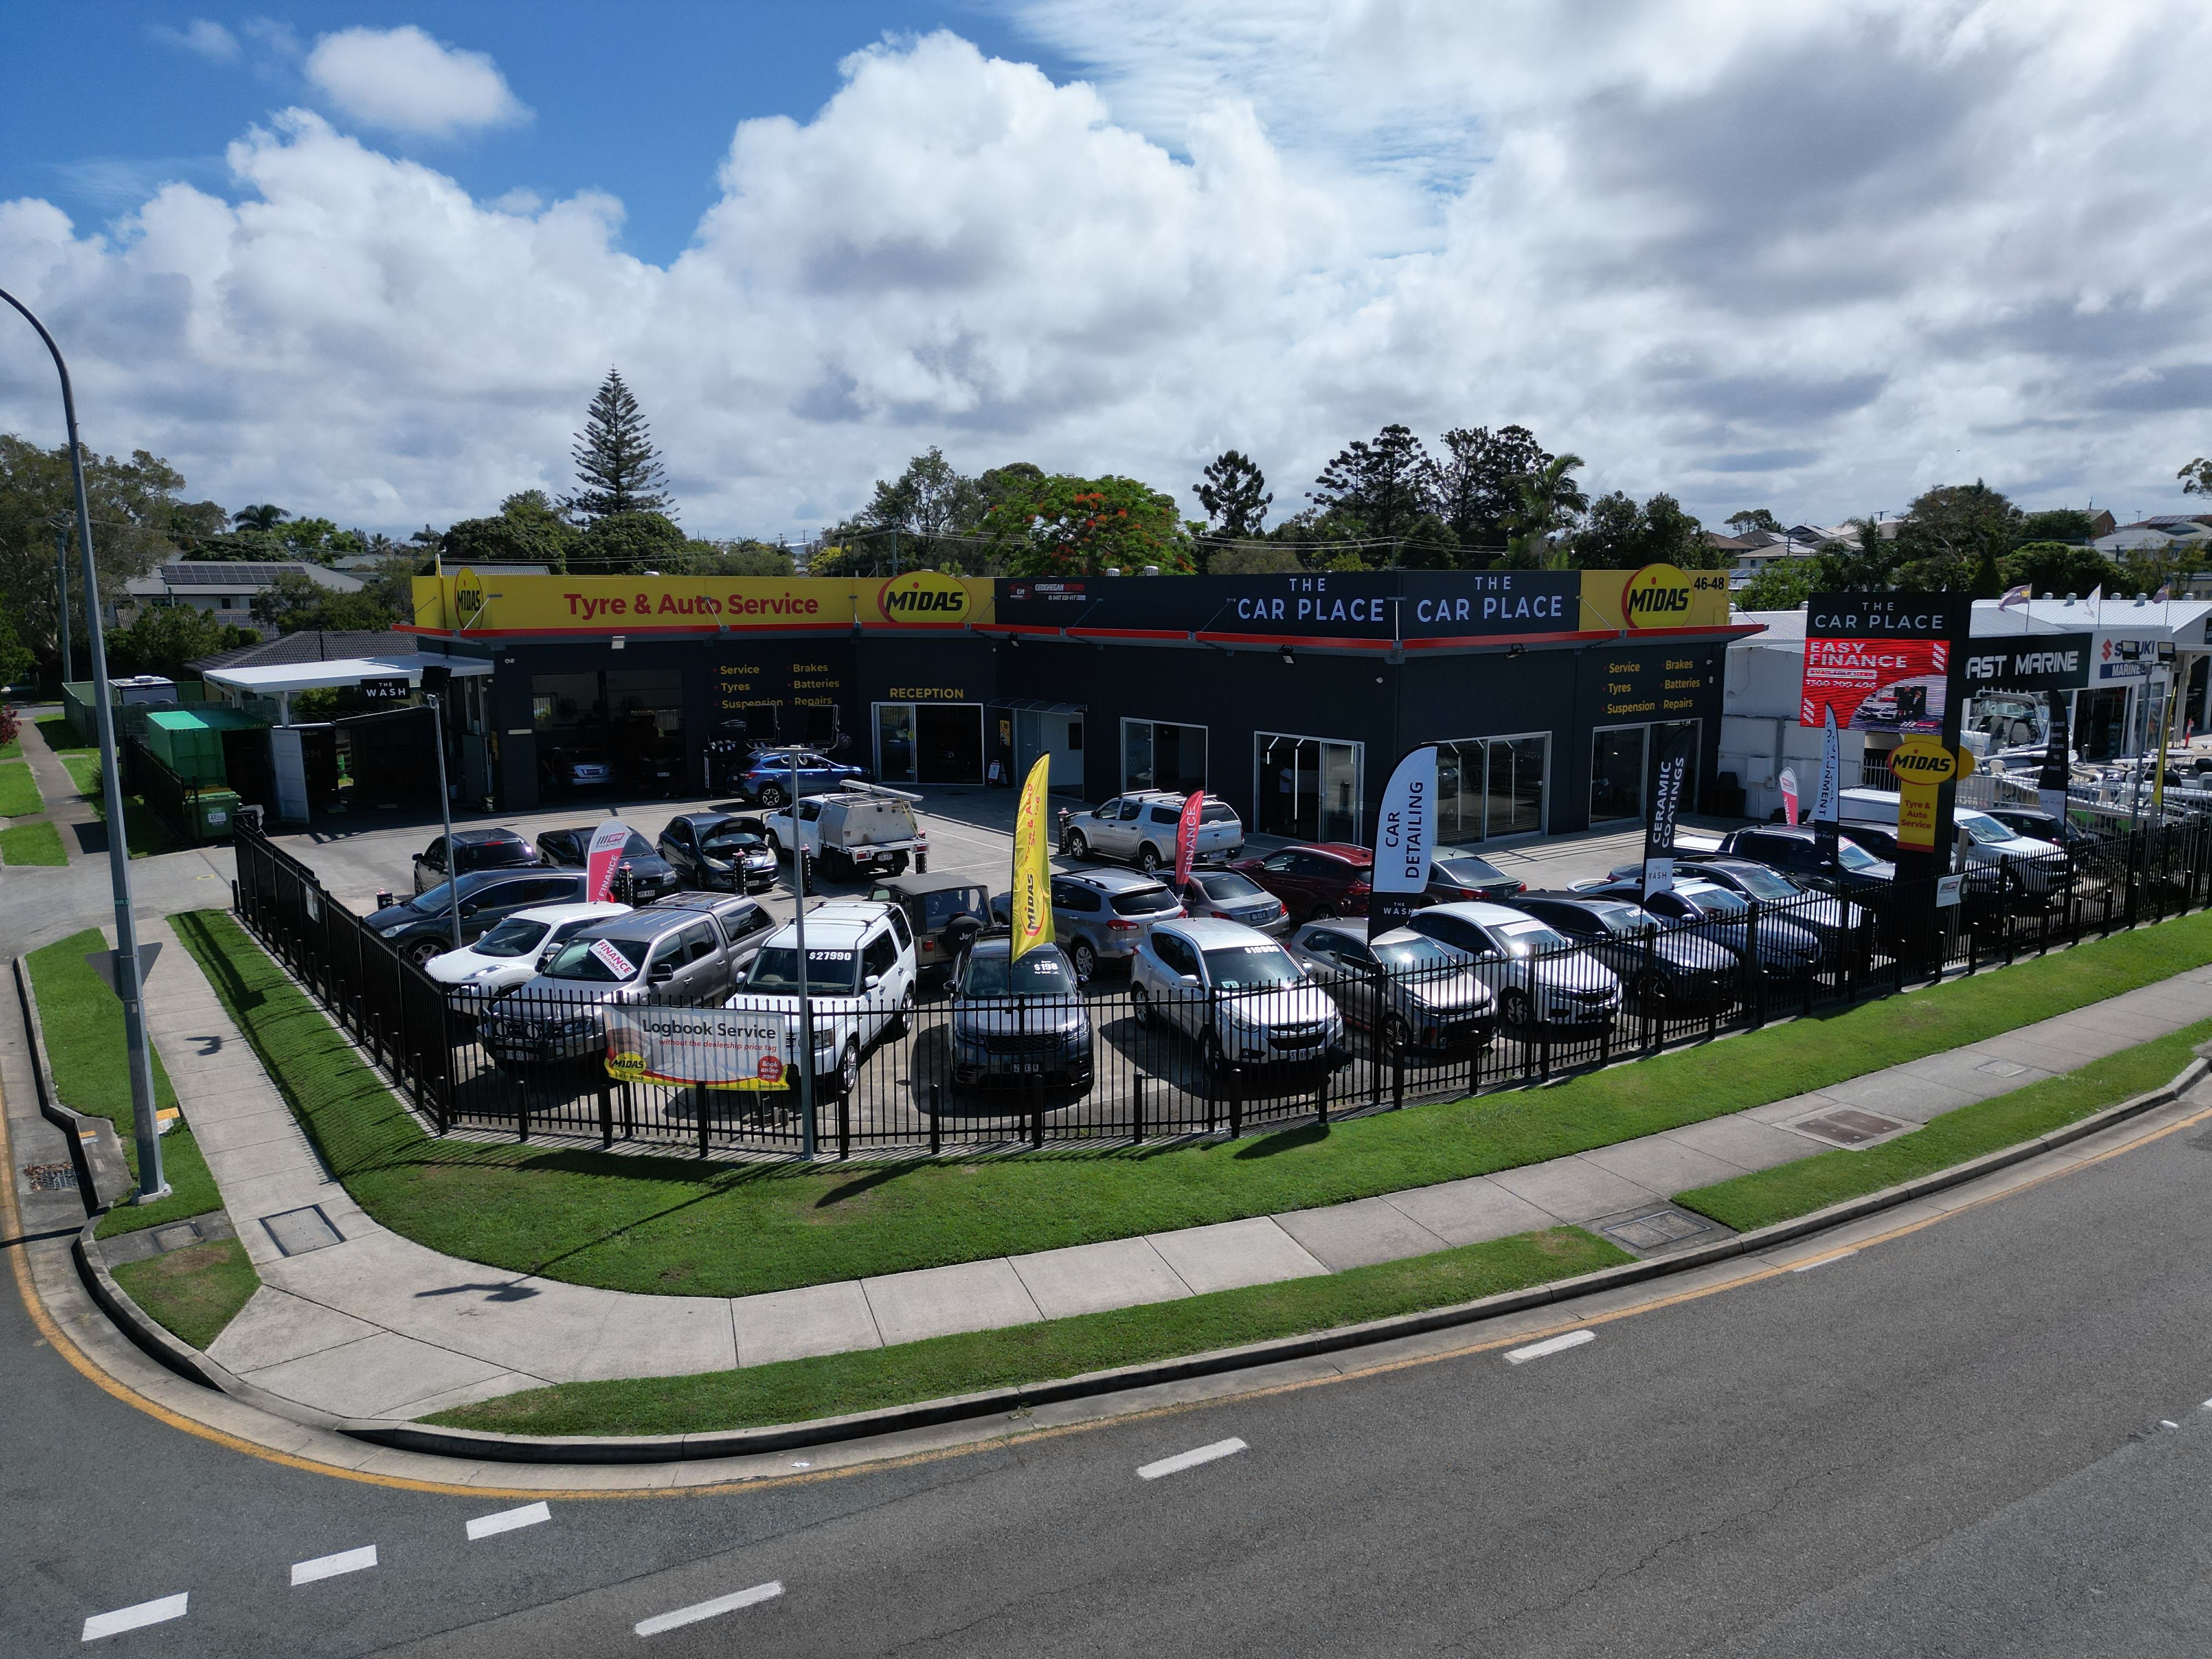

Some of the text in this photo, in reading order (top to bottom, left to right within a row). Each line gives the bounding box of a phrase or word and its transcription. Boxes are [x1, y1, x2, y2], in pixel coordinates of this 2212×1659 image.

[1289, 578, 1325, 591] THE
[1475, 576, 1511, 590] THE
[1694, 577, 1724, 590] 46-48
[457, 580, 480, 612] MIDAS
[887, 582, 963, 613] MIDAS
[1628, 577, 1690, 616] MIDAS
[564, 592, 819, 620] Tyre & Auto Service
[1238, 599, 1384, 621] CAR PLACE
[1417, 596, 1562, 622] CAR PLACE
[1863, 602, 1894, 611] THE
[1815, 614, 1943, 629] CAR PLACE
[1810, 641, 1866, 653] EASY
[2114, 640, 2155, 657] SUKI
[1609, 659, 1693, 673] Service Brakes
[1809, 654, 1907, 668] FINANCE
[1966, 651, 2079, 679] AST MARINE
[720, 663, 828, 675] Service Brakes
[2112, 664, 2141, 676] MARINE
[366, 688, 406, 697] WASH
[721, 679, 840, 693] Tyres Batteries
[890, 688, 964, 699] RECEPTION
[1609, 678, 1700, 695] Tyres Batteries
[794, 695, 833, 707] Repairs
[1607, 698, 1693, 715] Suspension Repairs
[1892, 749, 1951, 772] MIDAS
[1653, 761, 1672, 843] CERAMIC
[1662, 757, 1685, 848] COATINGS
[1904, 800, 1923, 810] Tyre
[1907, 810, 1927, 820] Auto
[1386, 811, 1400, 848] CAR
[1405, 781, 1424, 879] DETAILING
[1901, 819, 1931, 829] Service
[596, 841, 621, 849] FINANCE
[1184, 806, 1196, 874] FINANCE
[599, 854, 619, 896] FINANCE
[1025, 873, 1039, 930] MIDAS
[597, 941, 632, 974] FINANCE
[809, 952, 851, 961] $27990
[642, 1019, 776, 1039] Logbook Service
[659, 1039, 687, 1047] without
[703, 1040, 742, 1050] dealership
[744, 1042, 762, 1051] price
[765, 1043, 777, 1052] tag
[612, 1056, 644, 1069] MIDAS
